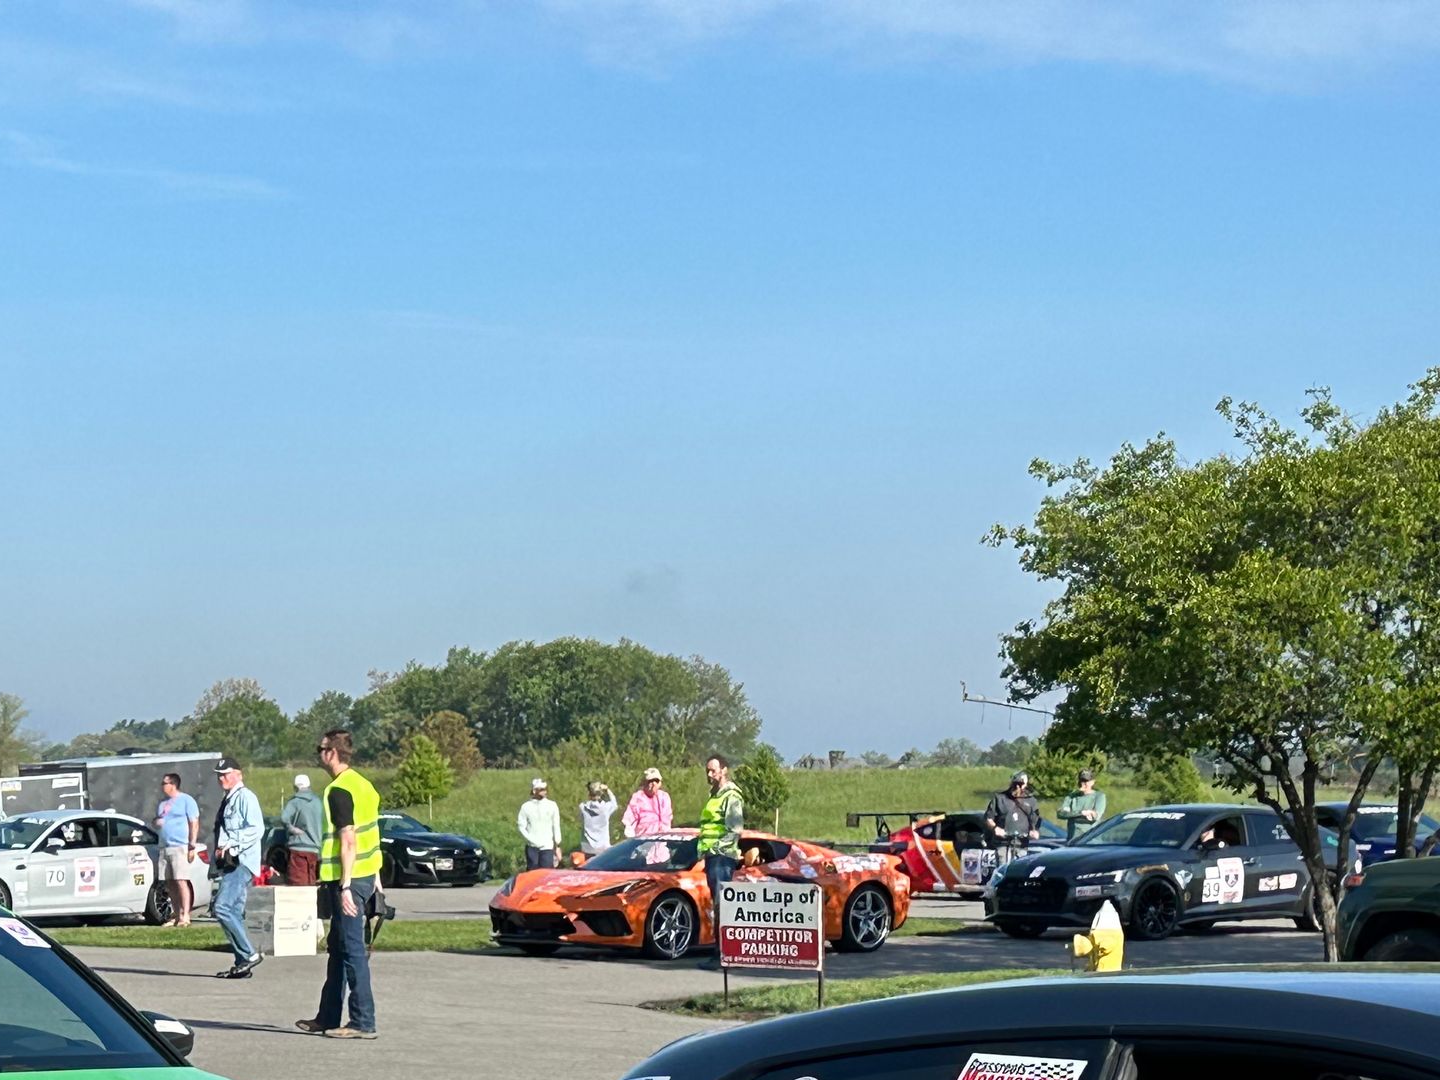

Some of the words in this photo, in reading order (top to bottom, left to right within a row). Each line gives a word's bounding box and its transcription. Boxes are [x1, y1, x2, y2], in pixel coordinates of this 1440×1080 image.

[48, 869, 65, 884] 70
[723, 887, 756, 902] One
[763, 888, 793, 907] Lap
[799, 889, 816, 904] of
[734, 907, 804, 923] America
[726, 928, 813, 943] COMPETITOR
[741, 942, 799, 957] PARKING
